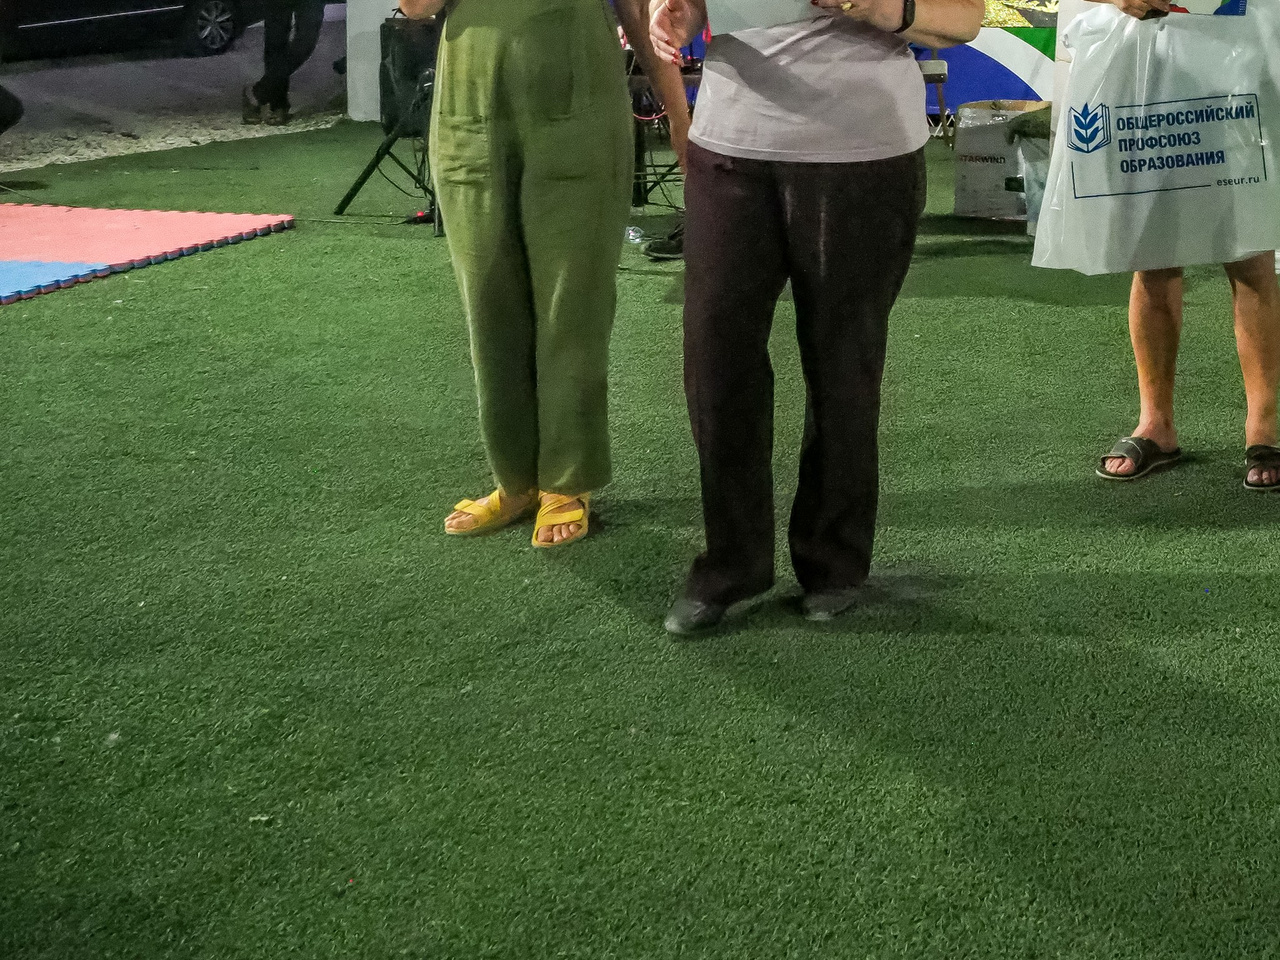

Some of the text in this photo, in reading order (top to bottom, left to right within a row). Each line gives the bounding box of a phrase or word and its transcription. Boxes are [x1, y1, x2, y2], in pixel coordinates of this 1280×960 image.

[1116, 101, 1256, 131] ОБЩЕРОССИЙСКИЙ
[1118, 131, 1201, 153] ПРОФСОЮЗ
[1120, 150, 1226, 174] ОБРАЗОВАНИЯ
[1216, 175, 1260, 187] eseur.ru
